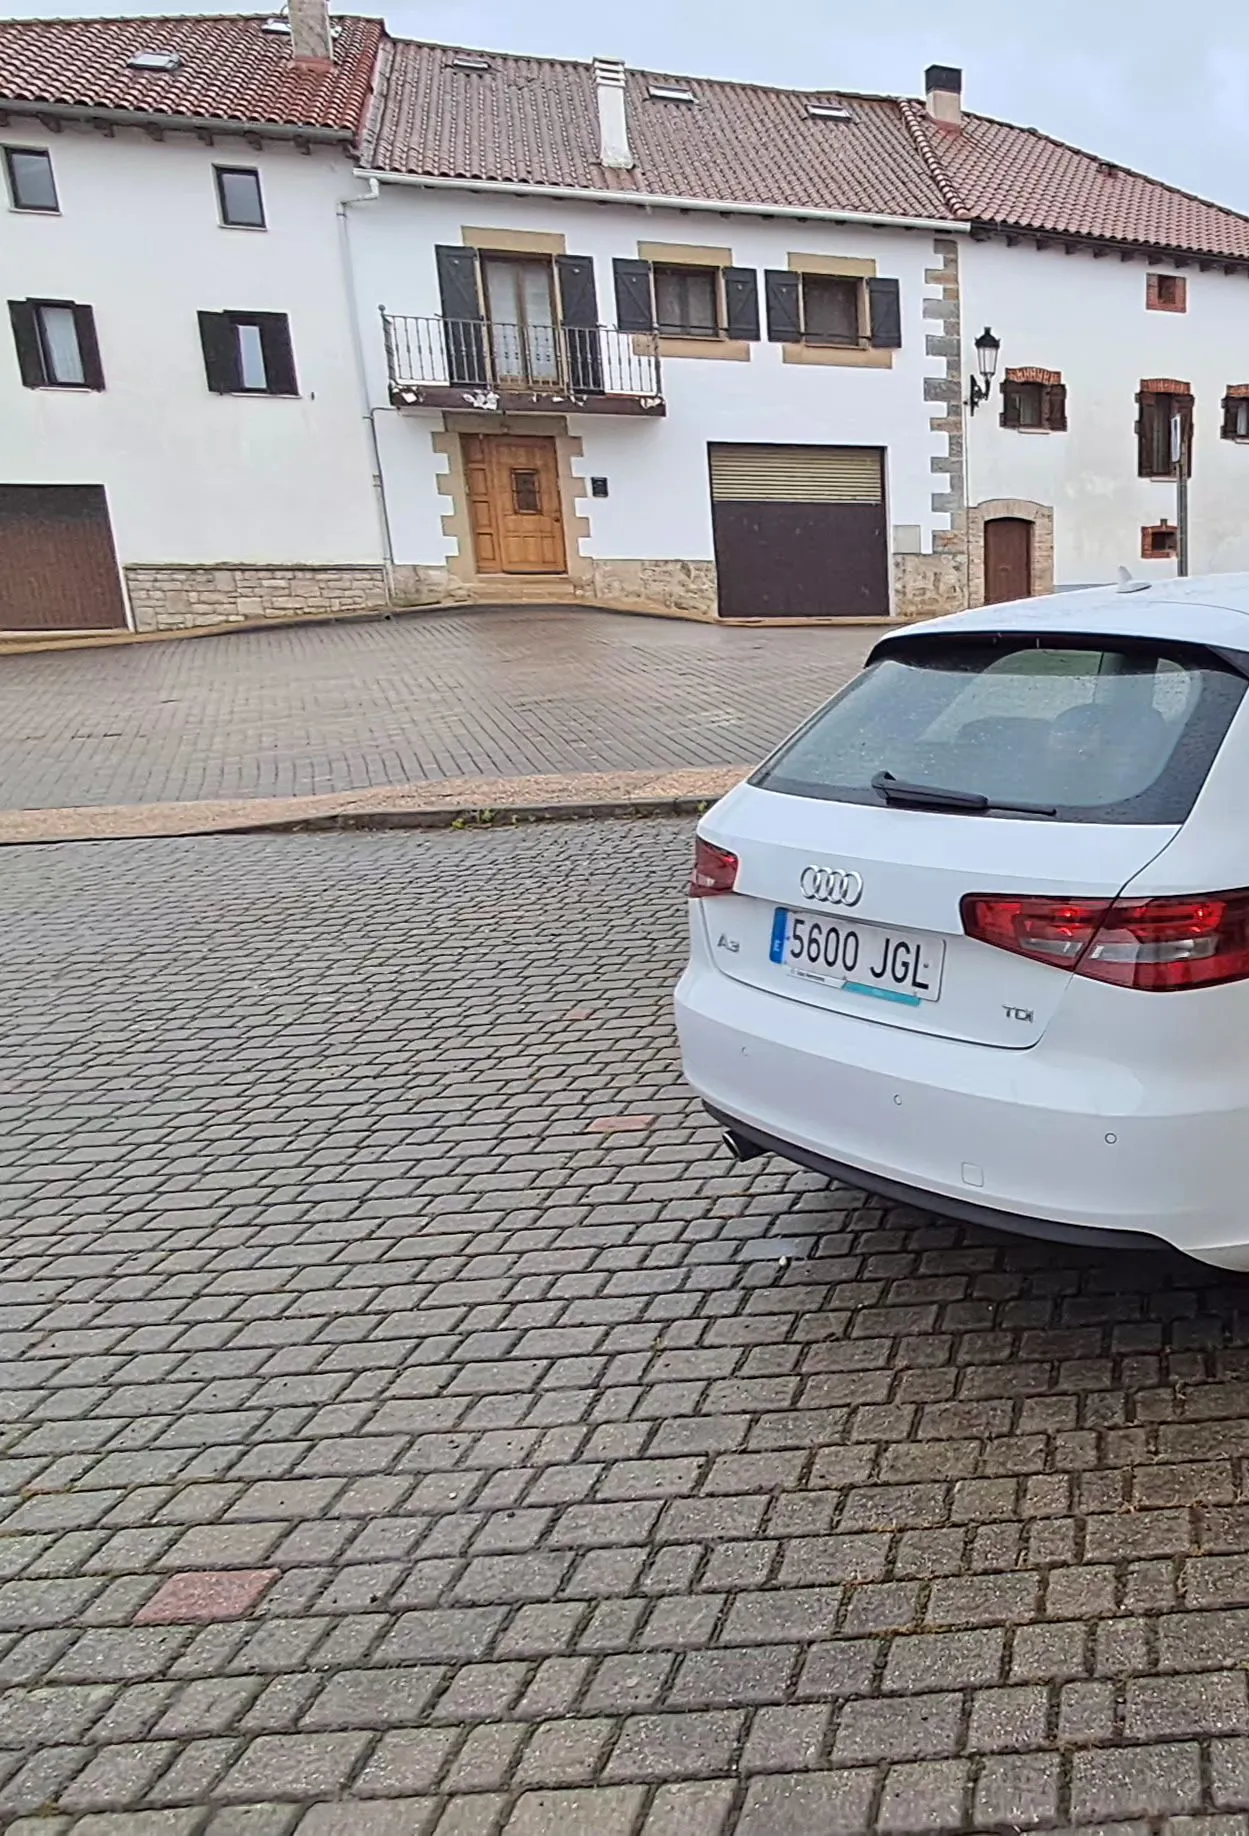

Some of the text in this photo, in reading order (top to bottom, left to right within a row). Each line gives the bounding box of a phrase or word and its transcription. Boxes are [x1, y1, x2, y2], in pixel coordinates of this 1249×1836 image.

[717, 934, 740, 953] A3
[790, 918, 929, 990] 5600 JGL
